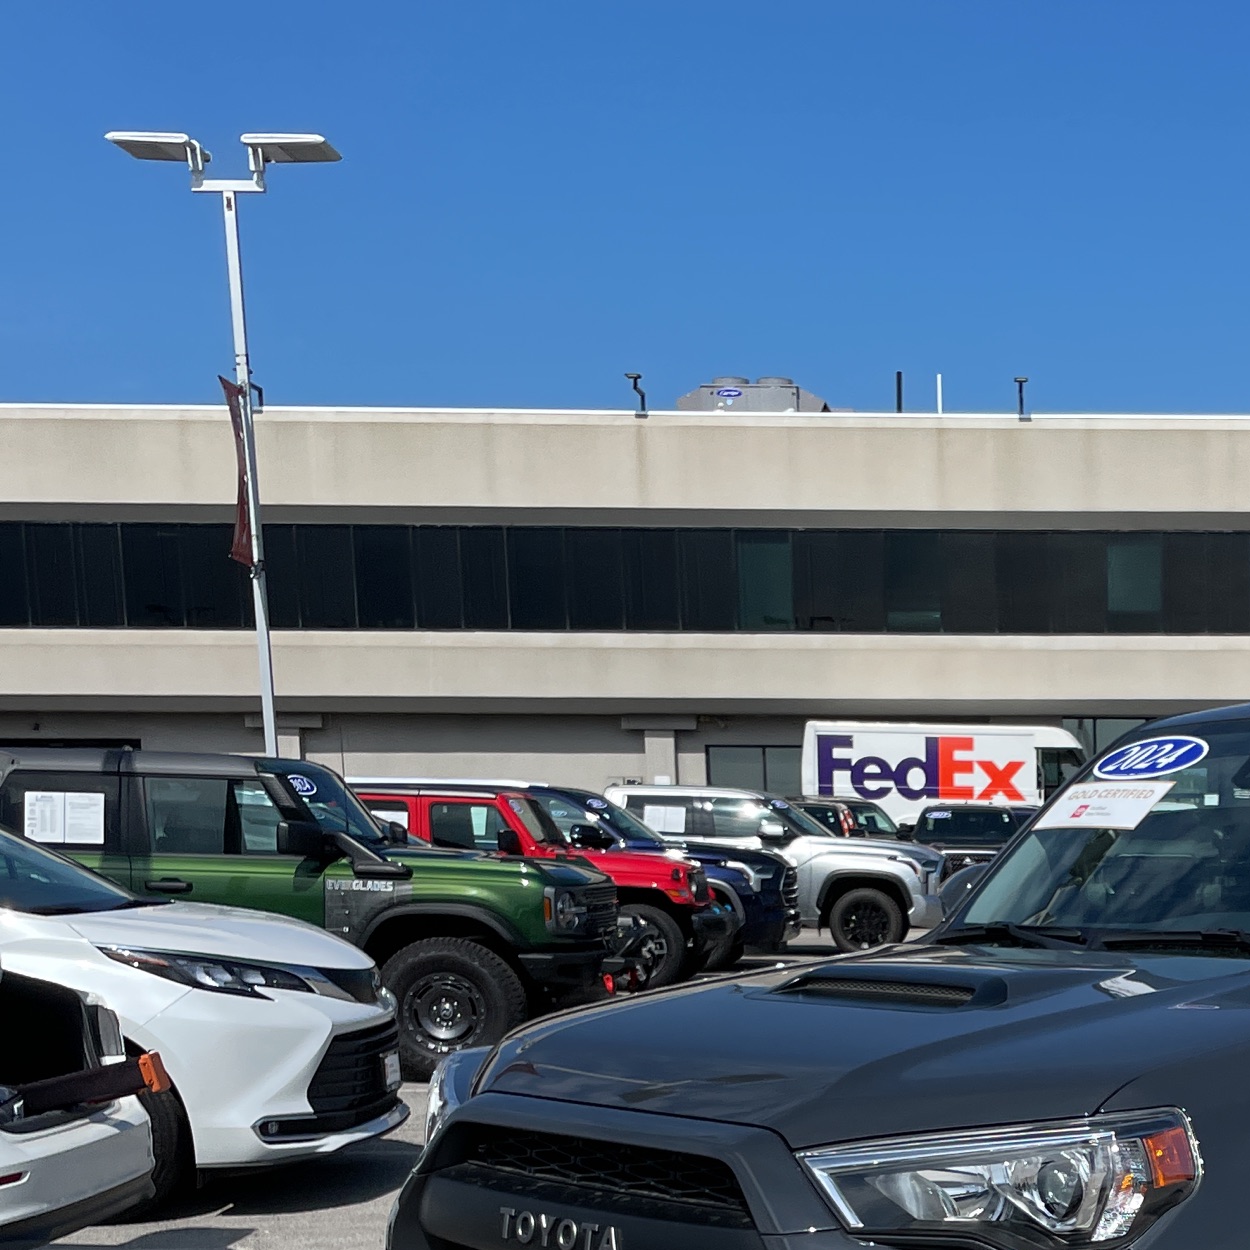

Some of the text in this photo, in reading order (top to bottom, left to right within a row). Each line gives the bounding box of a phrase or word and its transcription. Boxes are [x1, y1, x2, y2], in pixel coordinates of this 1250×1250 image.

[817, 734, 1027, 801] FedEx
[1100, 742, 1197, 773] 2024
[1067, 788, 1156, 801] GOLD CERTIFIED
